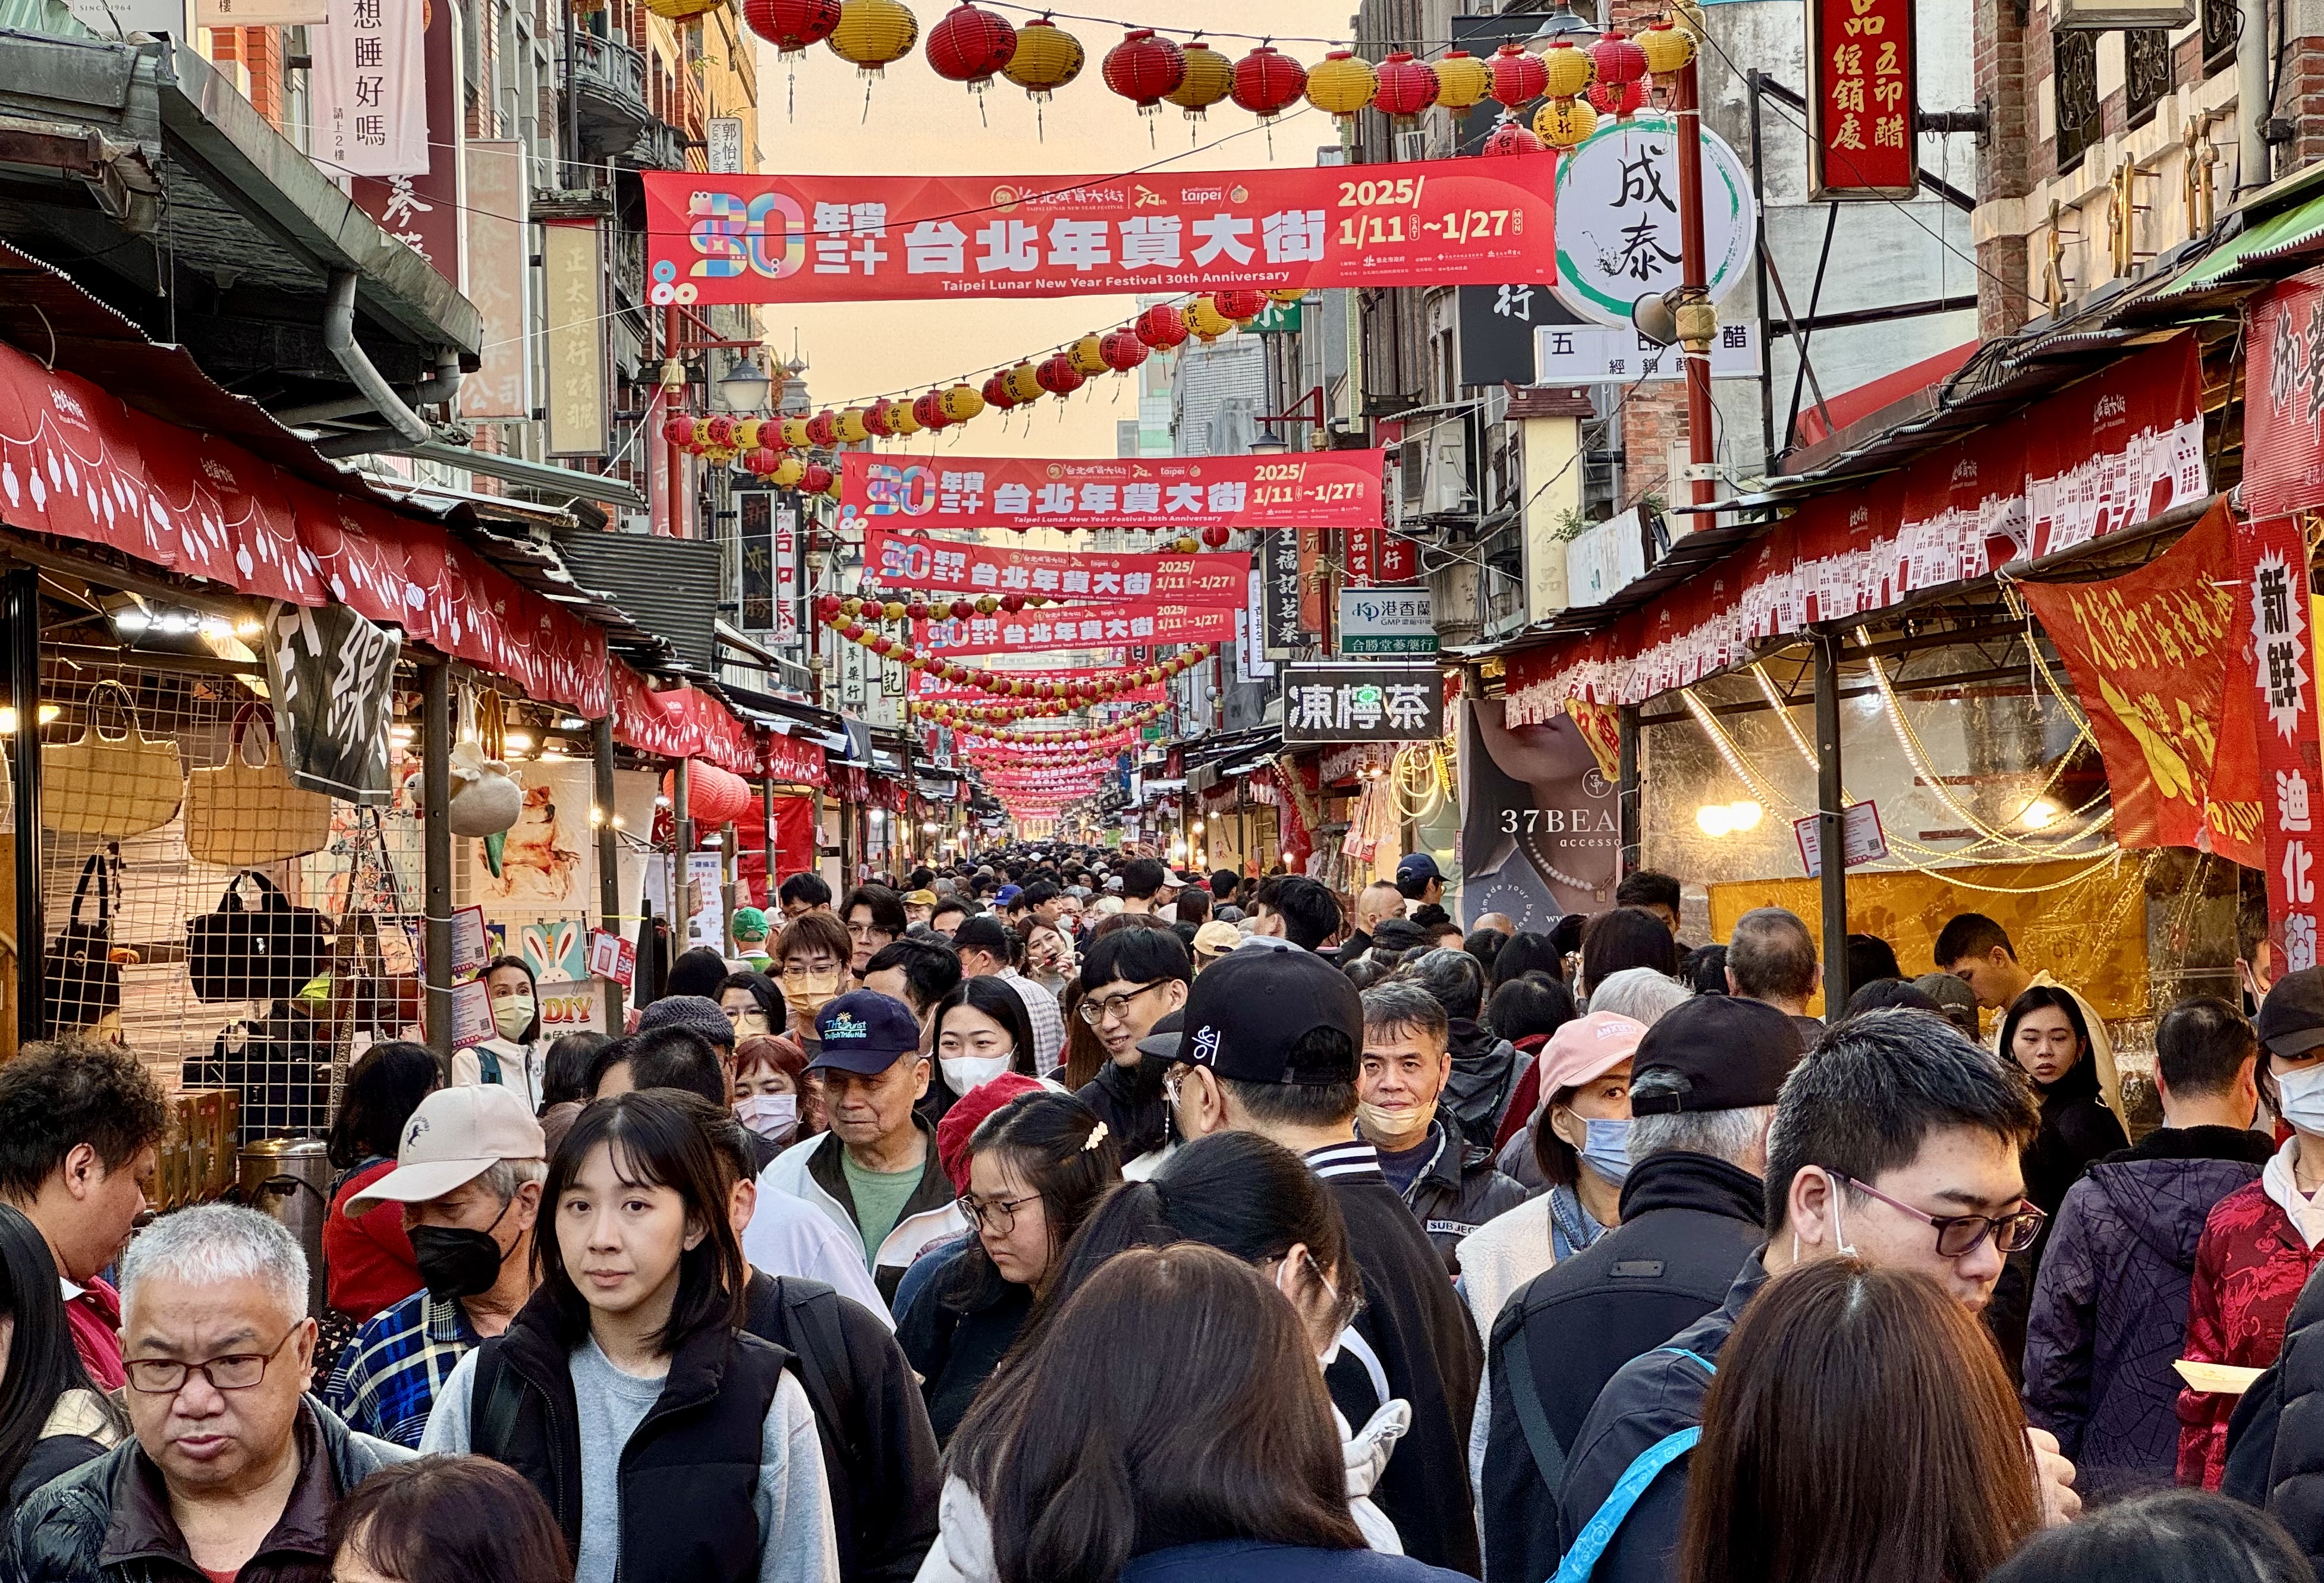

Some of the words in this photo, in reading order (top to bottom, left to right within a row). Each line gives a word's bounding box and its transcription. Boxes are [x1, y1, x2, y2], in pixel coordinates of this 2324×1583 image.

[353, 0, 385, 146] 想睡好嗎
[1832, 43, 1866, 151] 經銷處
[1875, 41, 1904, 149] 五印醋
[333, 107, 344, 161] 請上2樓
[712, 124, 721, 146] Kuo's
[713, 150, 722, 172] Astral
[1181, 188, 1222, 205] taipei
[1338, 175, 1425, 209] 2025/
[813, 201, 888, 239] 年貨
[1609, 143, 1683, 282] 成泰
[904, 209, 1326, 275] 台北年貨大街
[1339, 215, 1405, 250] 1/11
[813, 239, 888, 275] 三十
[942, 279, 986, 292] Taipei
[990, 279, 1033, 290] Lunar
[1036, 278, 1067, 288] New
[1070, 276, 1101, 288] Year
[1106, 274, 1162, 286] Festival
[1166, 273, 1199, 285] 30th
[1202, 270, 1290, 284] Anniversary
[734, 424, 746, 444] 台北
[784, 425, 794, 443] 台北
[836, 416, 848, 436] 台北
[941, 471, 985, 494] 年貨
[1254, 462, 1307, 483] 2025/
[939, 493, 984, 515] 三十
[993, 482, 1247, 515] 台北年貨大街
[1253, 485, 1293, 506] 1/11
[1014, 516, 1040, 525] Taipei
[1169, 515, 1222, 524] Anniversary
[933, 550, 966, 569] 年貨
[1156, 560, 1195, 575] 2025/
[1351, 527, 1369, 587] 品公司
[932, 567, 964, 583] 三十
[971, 562, 1152, 595] 台北年貨大街
[1155, 576, 1185, 591] 1/11
[1156, 605, 1187, 616] 2025/
[1381, 600, 1431, 616] 港香蘭
[1003, 616, 1153, 644] 台北年貨大街
[1158, 618, 1182, 631] 1/11
[2259, 566, 2297, 709] 新鮮
[1288, 684, 1430, 730] 凍檸茶
[1500, 809, 1618, 833] 37BEA
[1559, 836, 1622, 847] accesso
[2277, 767, 2317, 973] 迪化街
[1480, 884, 1502, 913] dmade
[1507, 883, 1529, 899] your
[1514, 904, 1533, 931] beaut
[542, 996, 593, 1025] DIY
